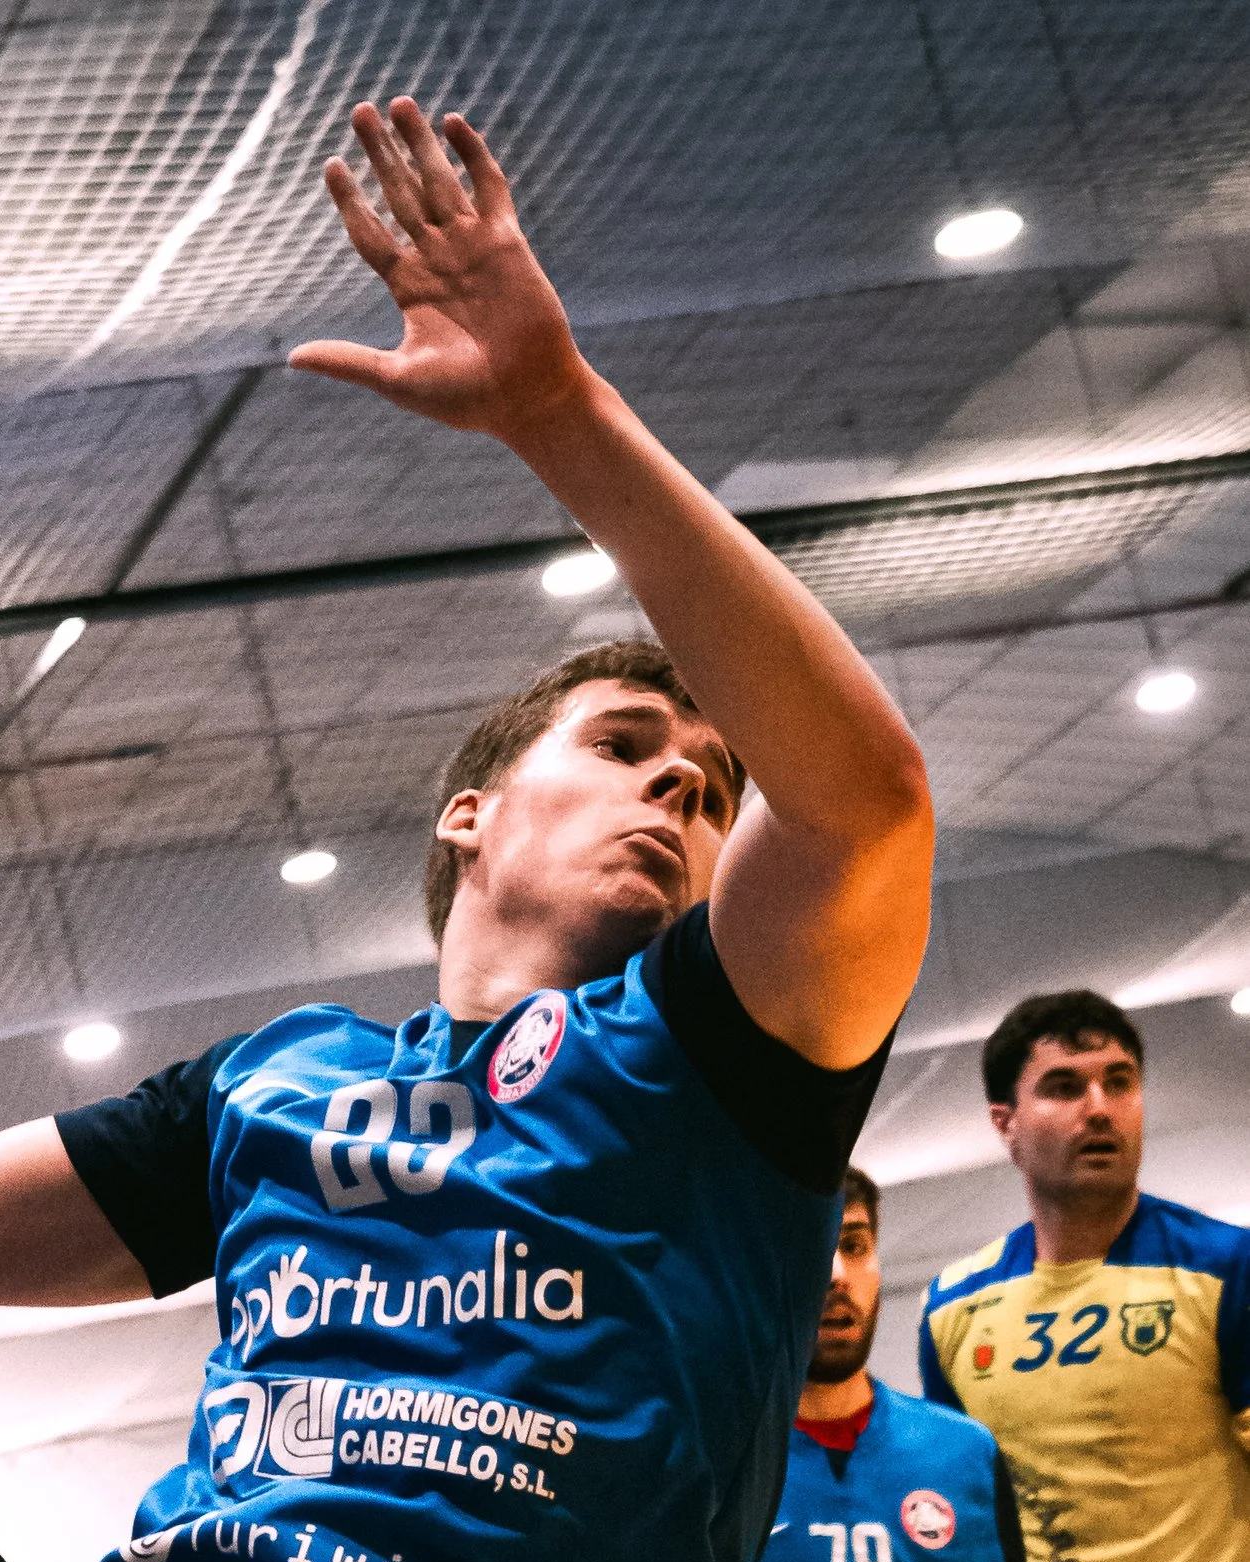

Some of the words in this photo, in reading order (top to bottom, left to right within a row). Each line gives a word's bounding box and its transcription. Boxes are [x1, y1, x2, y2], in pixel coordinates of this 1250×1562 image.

[1012, 1303, 1109, 1373] 32
[342, 1386, 578, 1456] HORMIGONES
[338, 1429, 504, 1493] CABELLO,
[510, 1462, 556, 1500] S.L.
